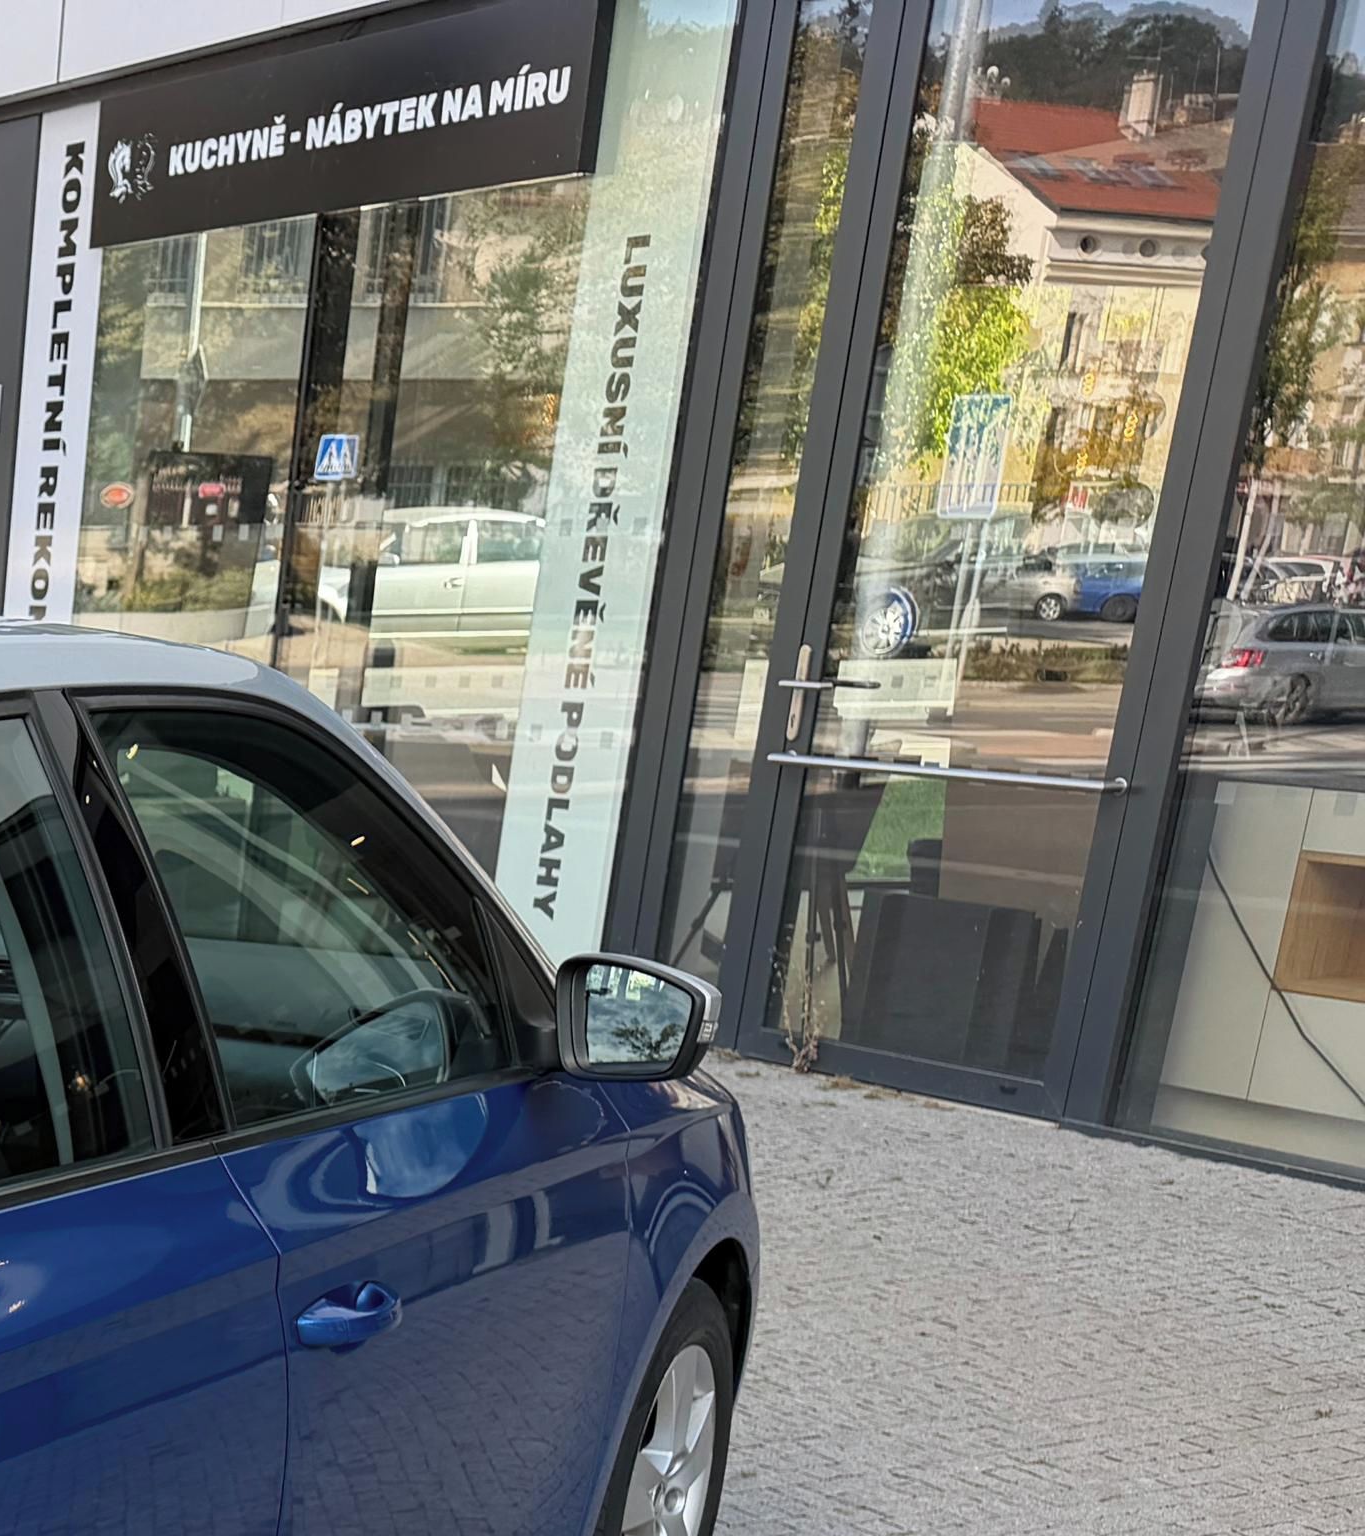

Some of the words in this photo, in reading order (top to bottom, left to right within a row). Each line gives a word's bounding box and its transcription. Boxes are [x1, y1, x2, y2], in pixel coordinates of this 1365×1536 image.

[168, 114, 287, 176] KUCHYNĚ
[305, 102, 437, 151] NÁBYTEK
[441, 83, 483, 125] NA
[488, 64, 571, 116] MÍRU
[41, 140, 86, 457] KOMPLETNÍ
[597, 234, 652, 459] LUXUSNÍ
[563, 467, 620, 691] DŘEVĚNÉ
[531, 701, 585, 921] PODLAHY
